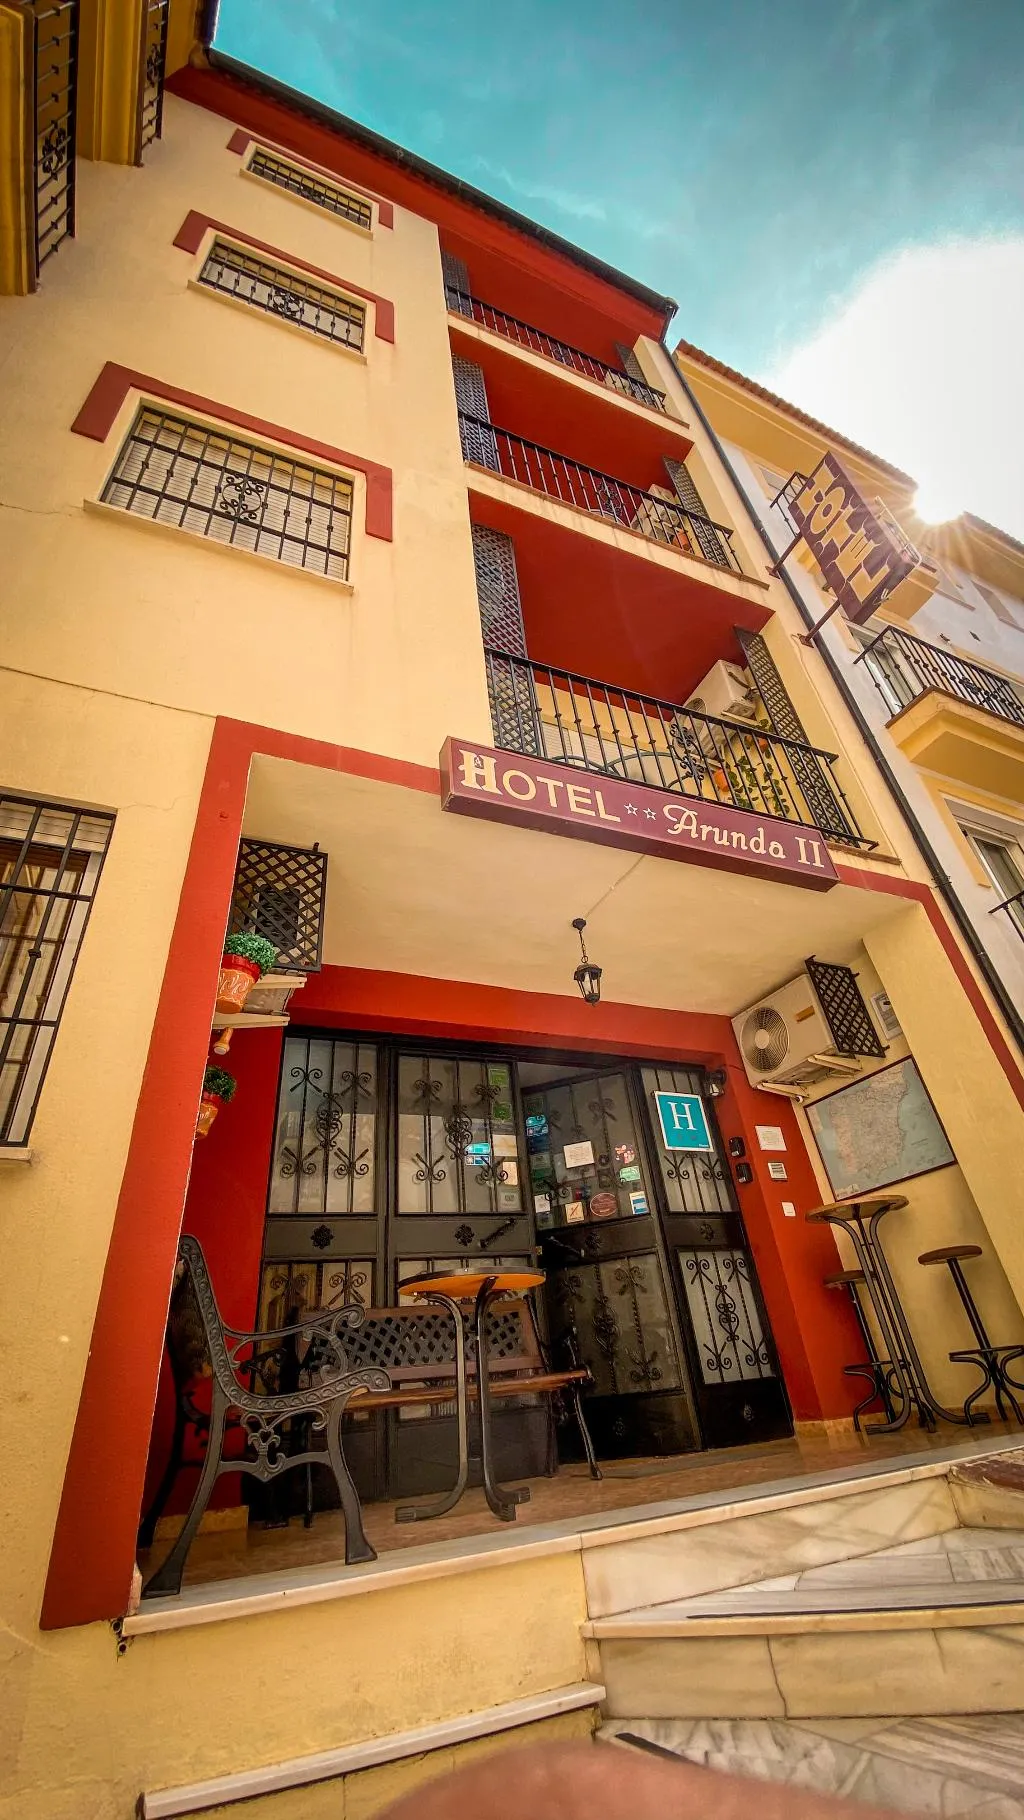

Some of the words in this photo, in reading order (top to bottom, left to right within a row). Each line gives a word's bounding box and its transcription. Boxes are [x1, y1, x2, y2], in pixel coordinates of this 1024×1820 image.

[795, 460, 891, 605] HOTEL
[458, 749, 621, 823] HOTEL
[663, 804, 786, 860] Arunda
[795, 836, 825, 868] II
[667, 1101, 699, 1131] H
